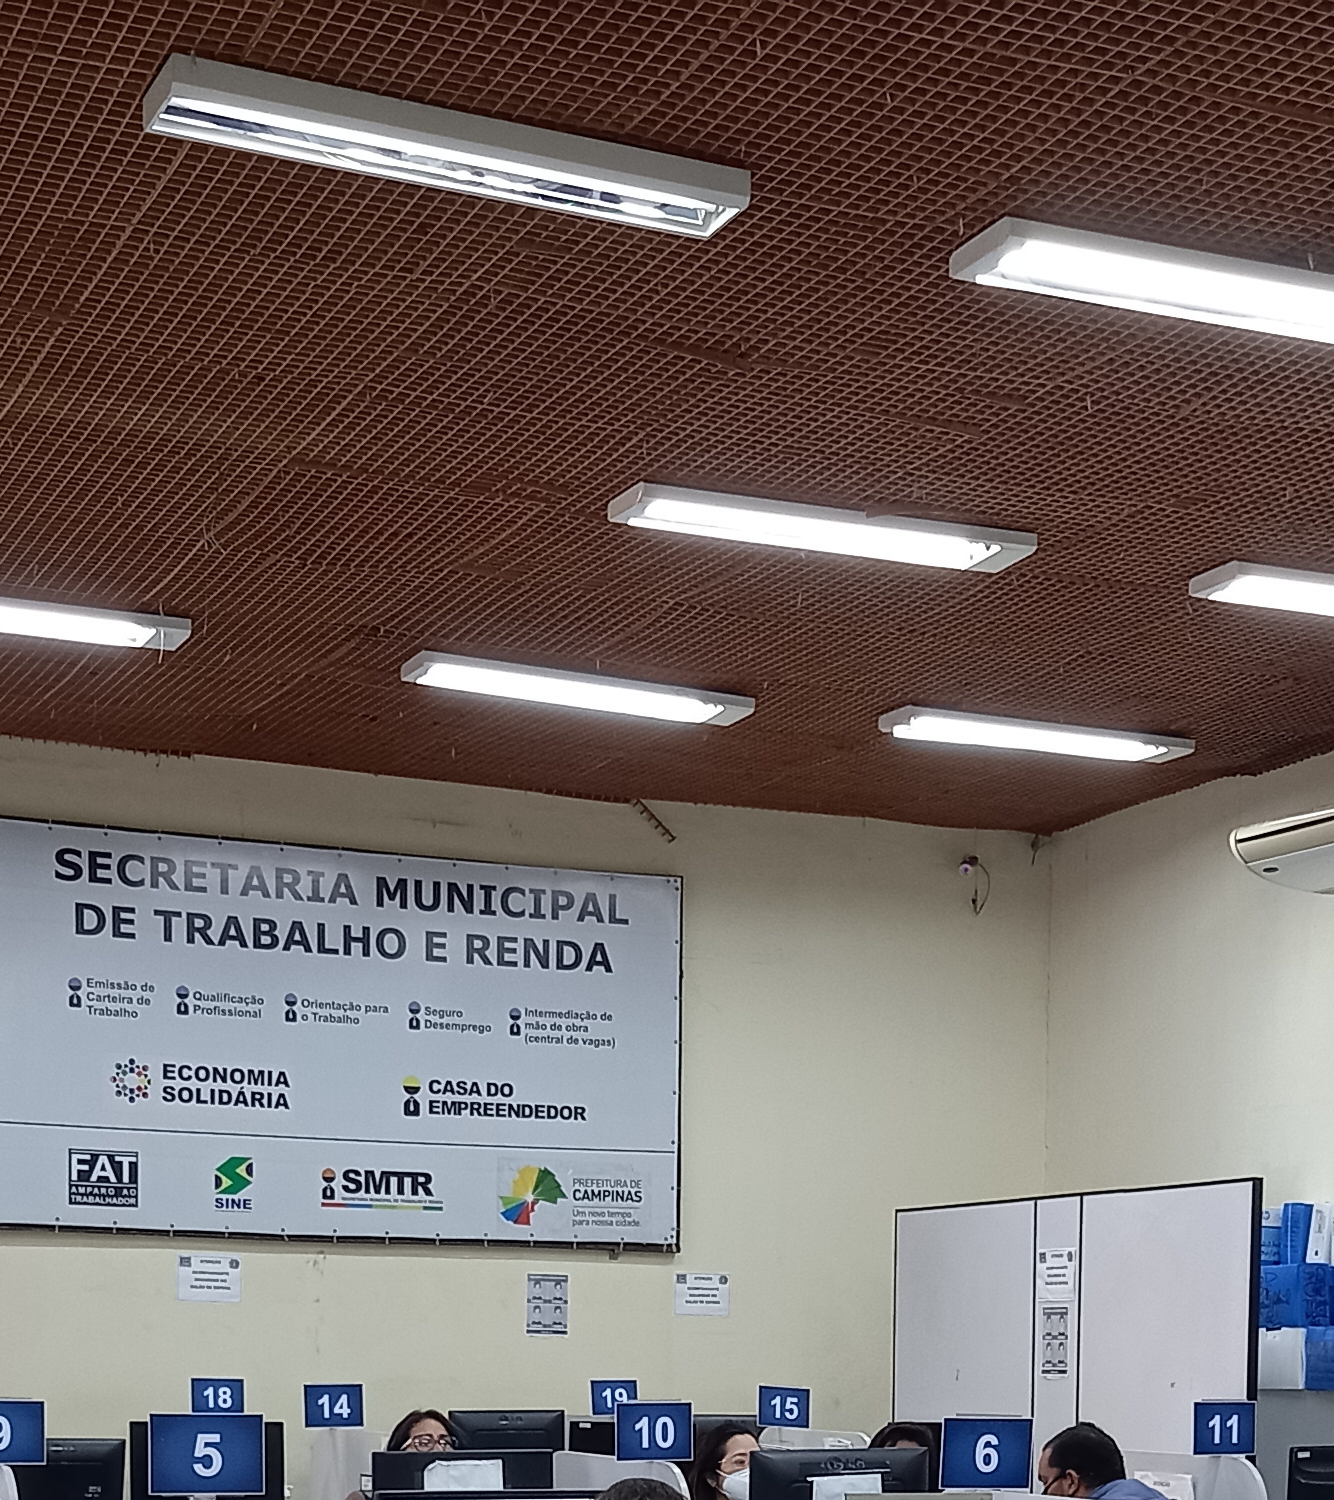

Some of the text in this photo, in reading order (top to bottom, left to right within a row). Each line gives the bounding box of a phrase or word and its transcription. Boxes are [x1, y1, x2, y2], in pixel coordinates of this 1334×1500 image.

[53, 847, 630, 926] SECRETARIA MUNICIPAL
[74, 901, 614, 974] DE TRABALHO E RENDA
[86, 977, 155, 993] Emissão de
[86, 991, 152, 1007] Carteira de
[192, 990, 265, 1008] Qualificação
[300, 998, 389, 1015] Orientação para
[86, 1004, 139, 1019] Trabalho
[192, 1004, 262, 1019] Profissional
[300, 1012, 360, 1025] o Trabalho
[424, 1006, 463, 1020] Seguro
[524, 1007, 613, 1022] Intermediação de
[424, 1019, 492, 1034] Desemprego
[524, 1021, 589, 1034] mão de obra
[524, 1033, 616, 1049] (central de vagas)
[162, 1063, 291, 1089] ECONOMIA
[428, 1078, 515, 1098] CASA DO
[161, 1086, 291, 1110] SOLIDÁRIA
[428, 1099, 587, 1121] EMPREENDEDOR
[70, 1153, 137, 1184] FAT
[341, 1168, 435, 1197] SMTR
[572, 1177, 643, 1190] PREFEITURA DE
[70, 1187, 137, 1197] AMPARO AO
[70, 1194, 137, 1206] TRABALHADOR
[572, 1188, 643, 1203] CAMPINAS
[214, 1198, 253, 1211] SINE
[572, 1208, 633, 1221] Um novo tempo
[201, 1386, 233, 1410] 18
[316, 1393, 351, 1419] 14
[770, 1395, 799, 1420] 15
[633, 1415, 676, 1451] 10
[1207, 1414, 1241, 1444] 11
[191, 1433, 223, 1477] 5
[974, 1433, 1000, 1474] 6
